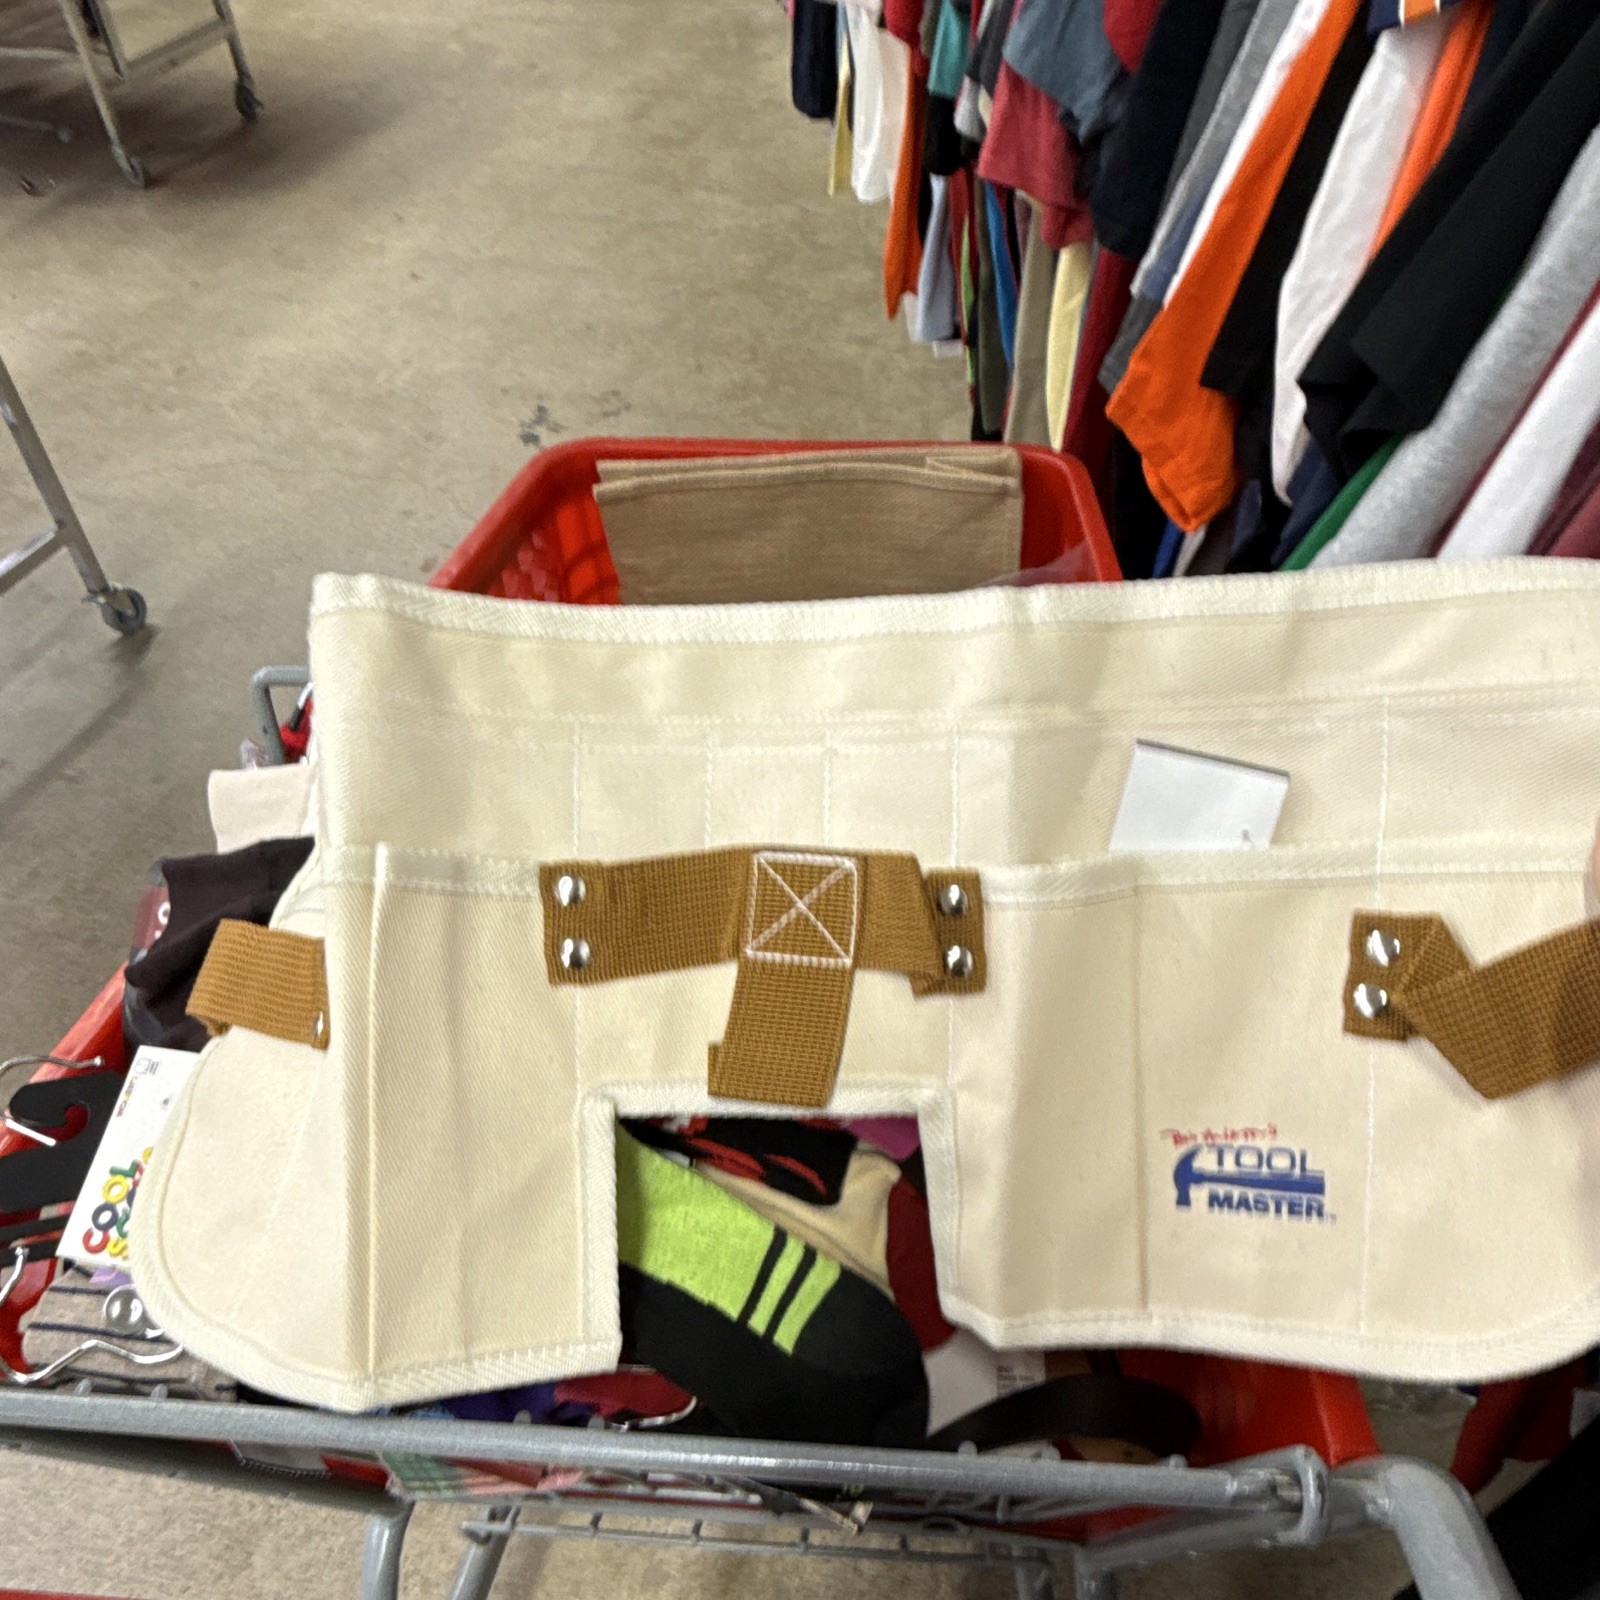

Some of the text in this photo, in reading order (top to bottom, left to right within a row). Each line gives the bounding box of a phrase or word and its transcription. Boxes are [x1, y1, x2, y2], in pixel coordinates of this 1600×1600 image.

[1207, 1143, 1324, 1177] TOOL
[82, 1159, 139, 1254] COOL
[1208, 1189, 1325, 1222] MASTER
